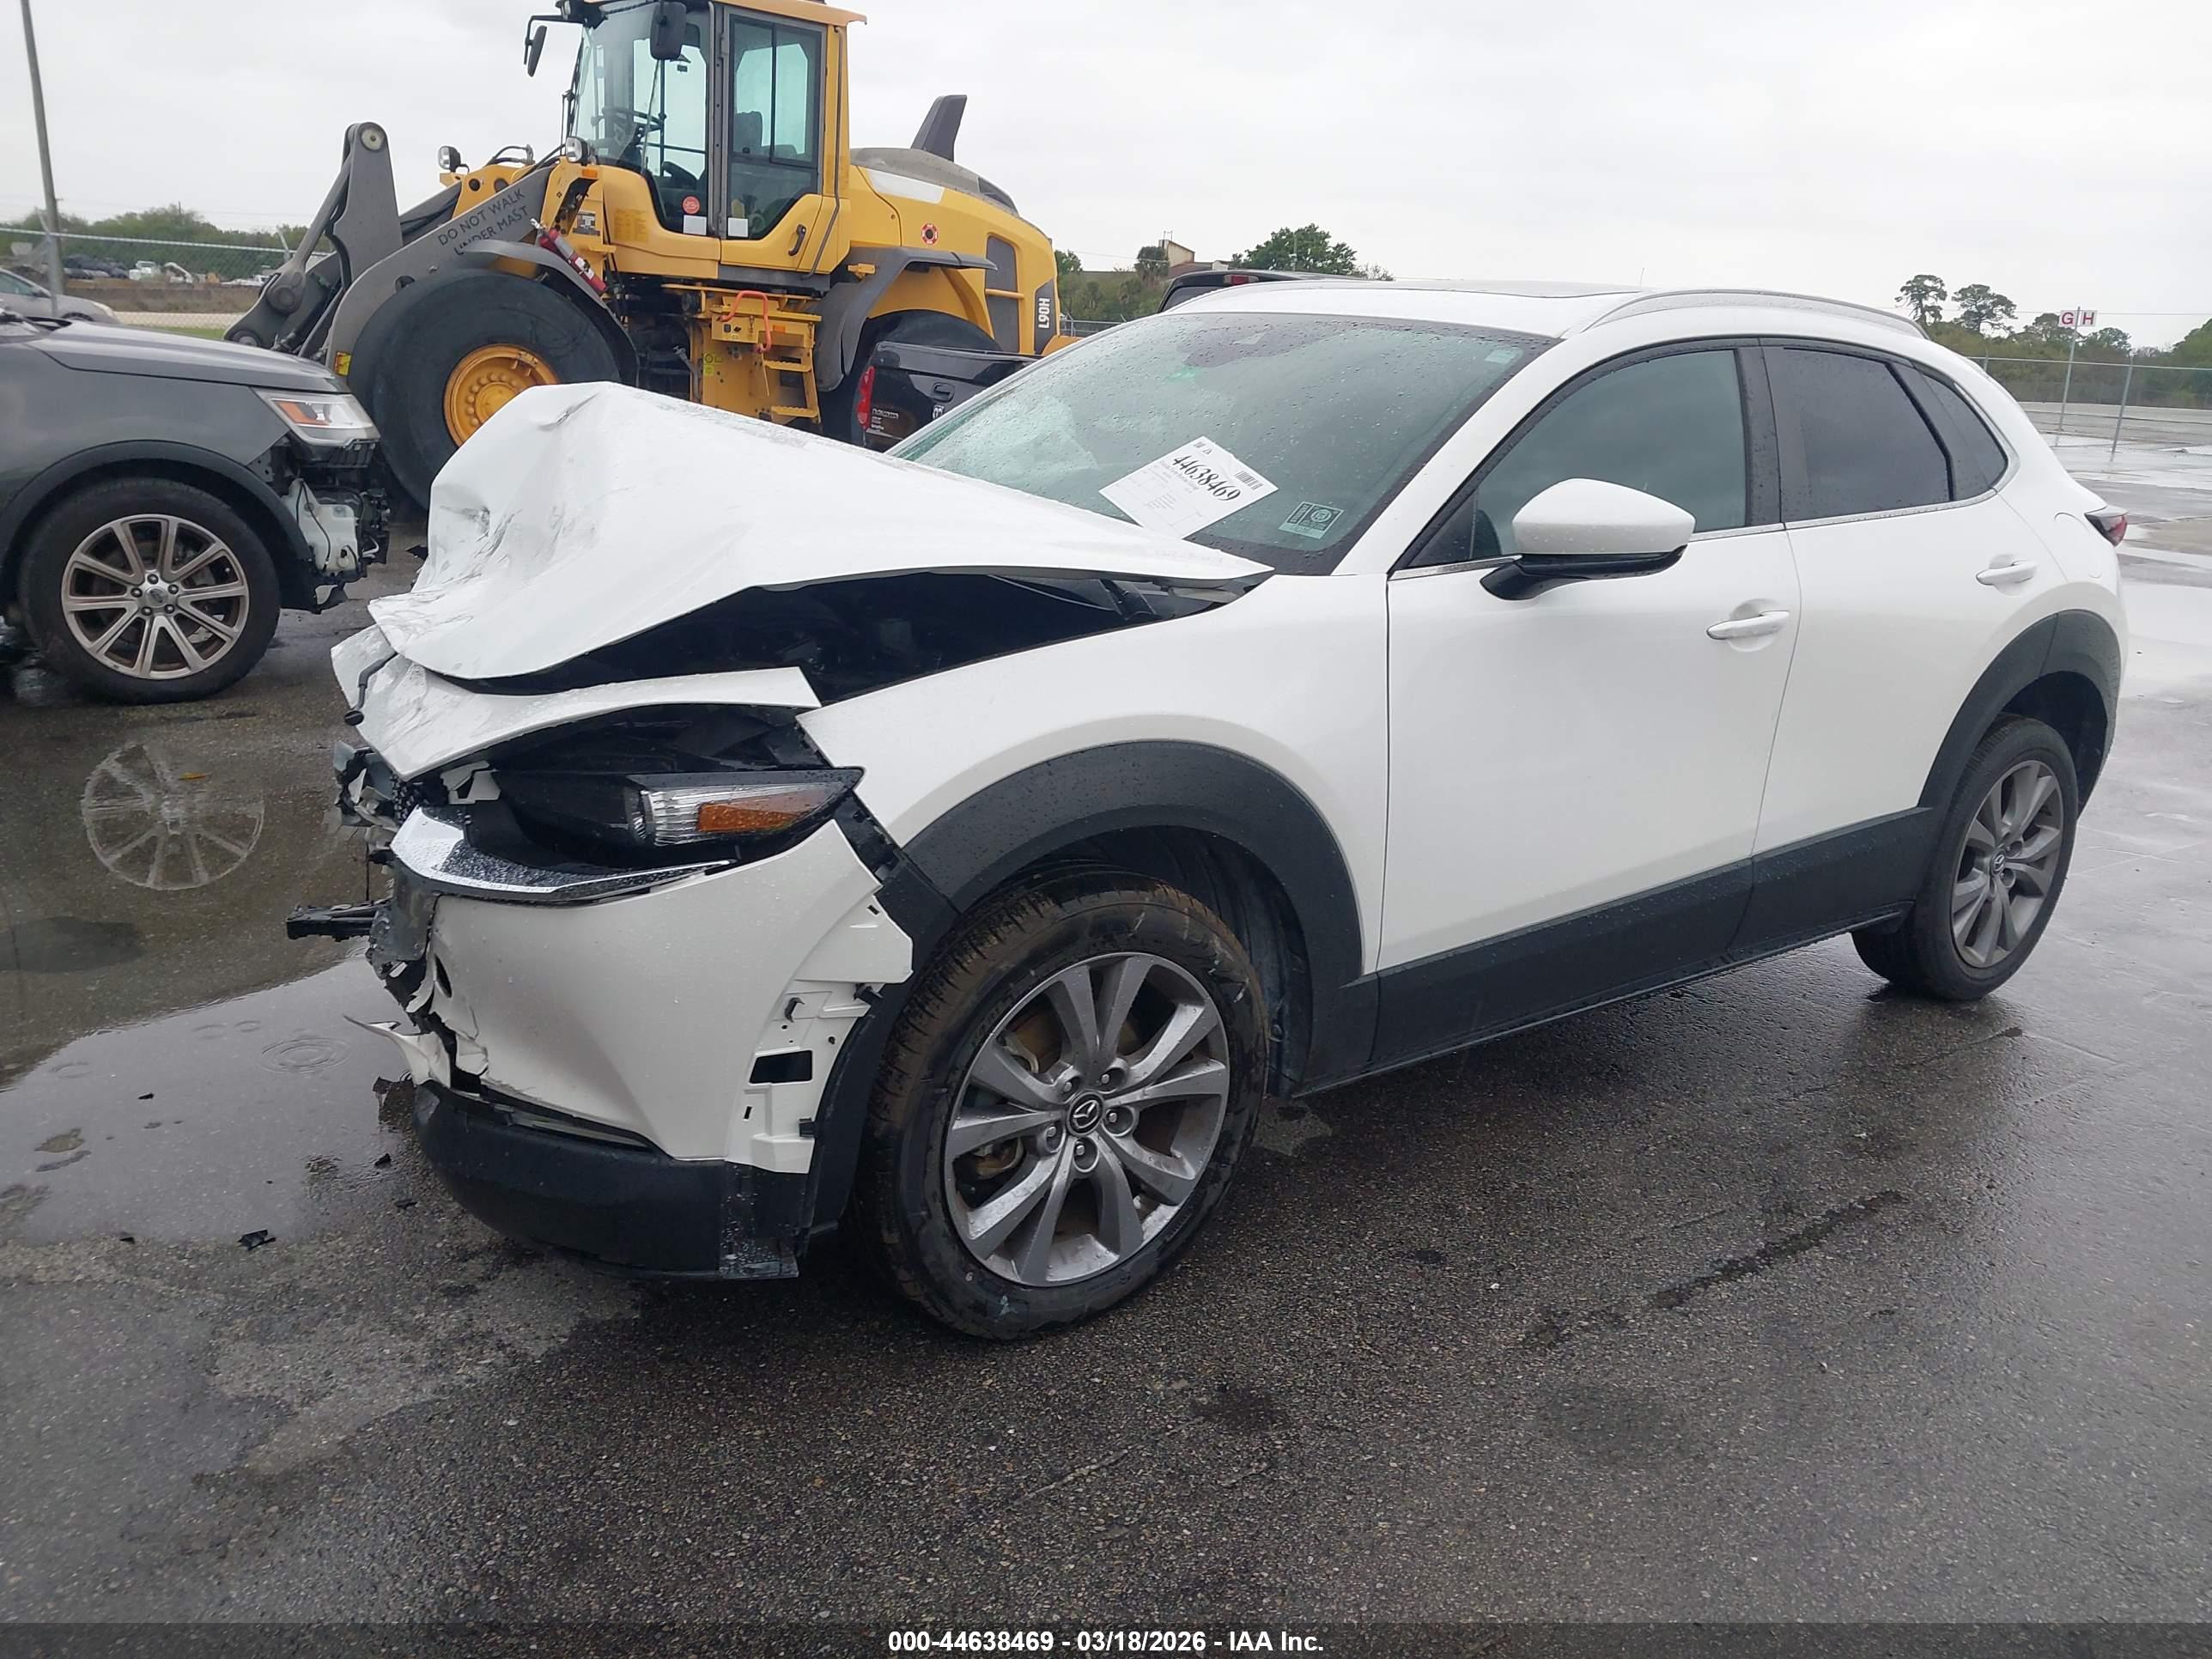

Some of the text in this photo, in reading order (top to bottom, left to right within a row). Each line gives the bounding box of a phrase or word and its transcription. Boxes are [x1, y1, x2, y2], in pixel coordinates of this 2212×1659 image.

[438, 188, 525, 246] DO NOT WALK
[496, 205, 528, 231] MAST
[1038, 297, 1050, 328] L90H
[2062, 312, 2074, 325] G
[2082, 312, 2094, 325] H
[1172, 455, 1241, 501] 44638469
